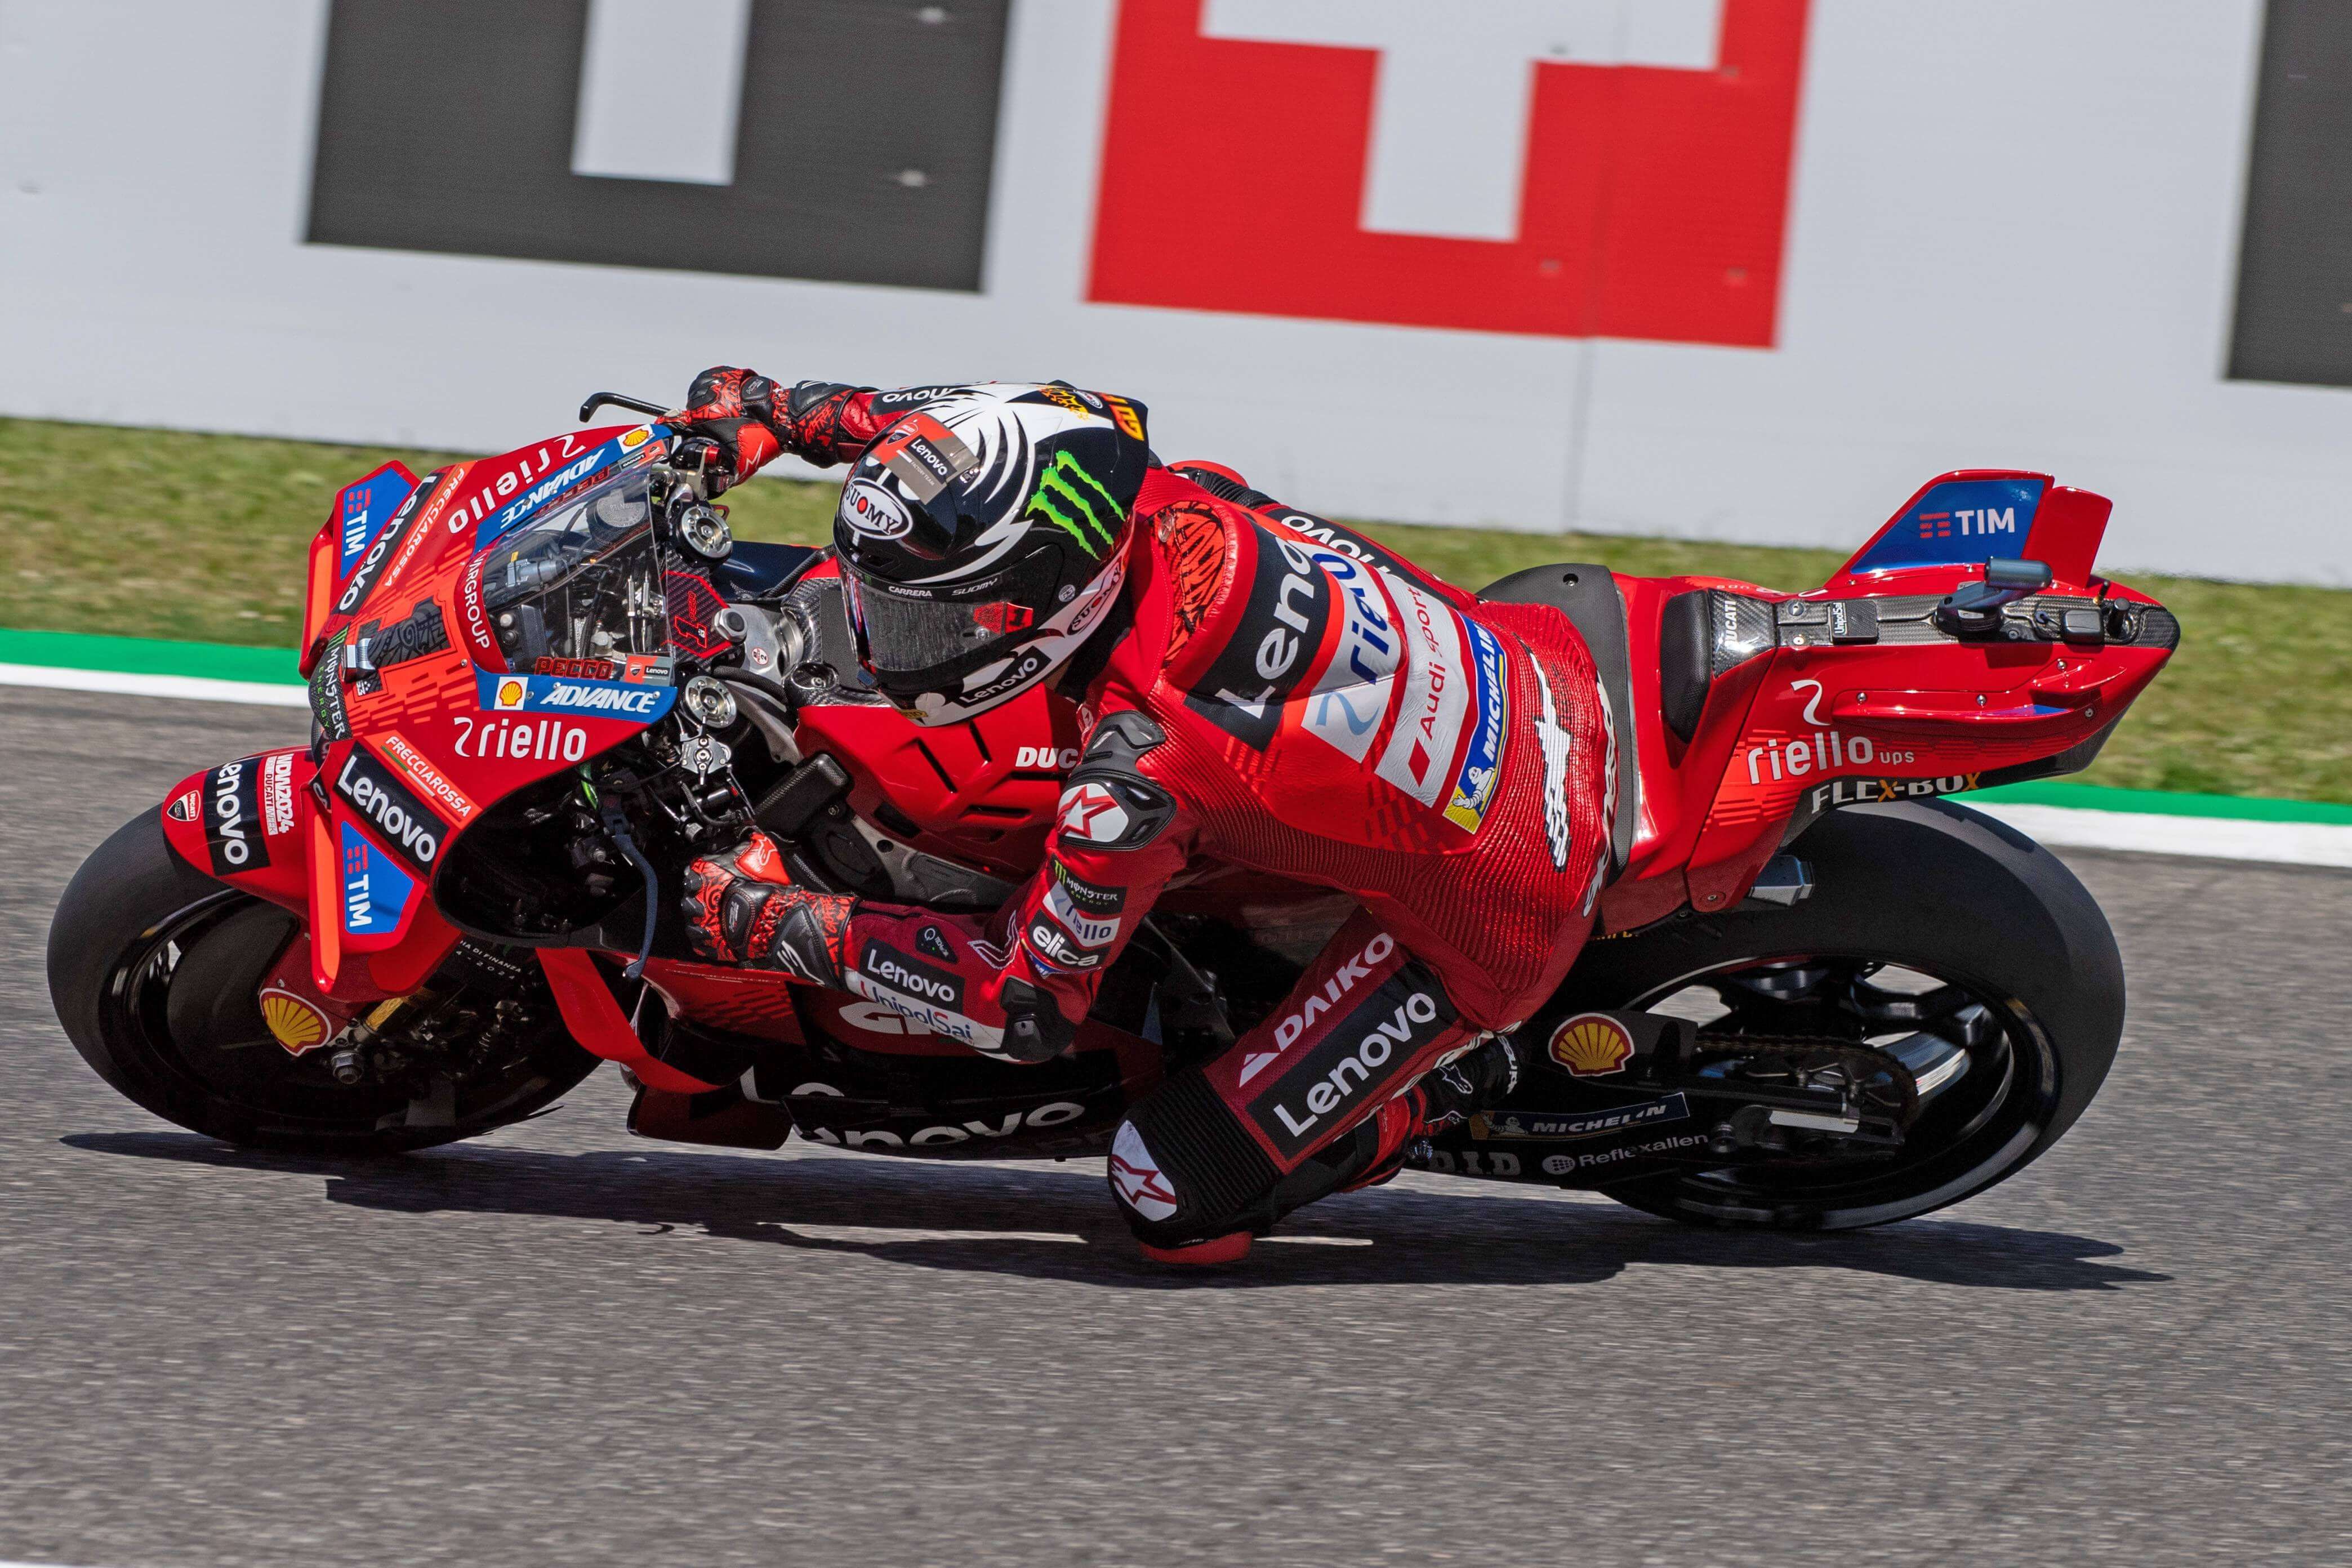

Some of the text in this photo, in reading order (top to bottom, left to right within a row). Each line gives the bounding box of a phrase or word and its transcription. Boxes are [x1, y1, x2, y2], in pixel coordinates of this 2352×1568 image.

[910, 438, 948, 476] Lenovo
[911, 461, 935, 487] FACTORY TEAM
[447, 448, 550, 534] riello
[500, 448, 605, 529] ADVANCE
[845, 485, 899, 536] SUOMY
[338, 475, 438, 611] Lenovo
[345, 510, 367, 556] TIM
[382, 467, 466, 587] FRECCIAROSSA
[1955, 507, 2015, 536] TIM
[465, 553, 491, 649] VARGROUP
[888, 586, 933, 597] CARRERA
[951, 578, 998, 596] SUOMY
[1215, 536, 1315, 719] Leno
[534, 656, 614, 681] PECCO
[645, 667, 669, 675] Lenovo
[960, 657, 1038, 703] Lenovo
[1407, 586, 1446, 741] Audi sport
[540, 685, 656, 714] ADVANCE
[1473, 622, 1502, 763] MICHELIN
[478, 718, 587, 762] riello
[1015, 746, 1078, 769] DUC
[1748, 731, 1915, 786] riello ups
[385, 736, 472, 818] FRECCIAROSSA
[1811, 772, 1981, 814] FLEX-BOX
[338, 755, 437, 863] Lenovo
[348, 874, 372, 928] TIM
[483, 953, 522, 973] FINANZA
[1033, 925, 1099, 966] elica
[867, 948, 955, 1002] Lenovo
[860, 981, 972, 1040] UnipolSai
[1274, 992, 1437, 1137] Lenovo
[1579, 1134, 1709, 1167] Reflexallen
